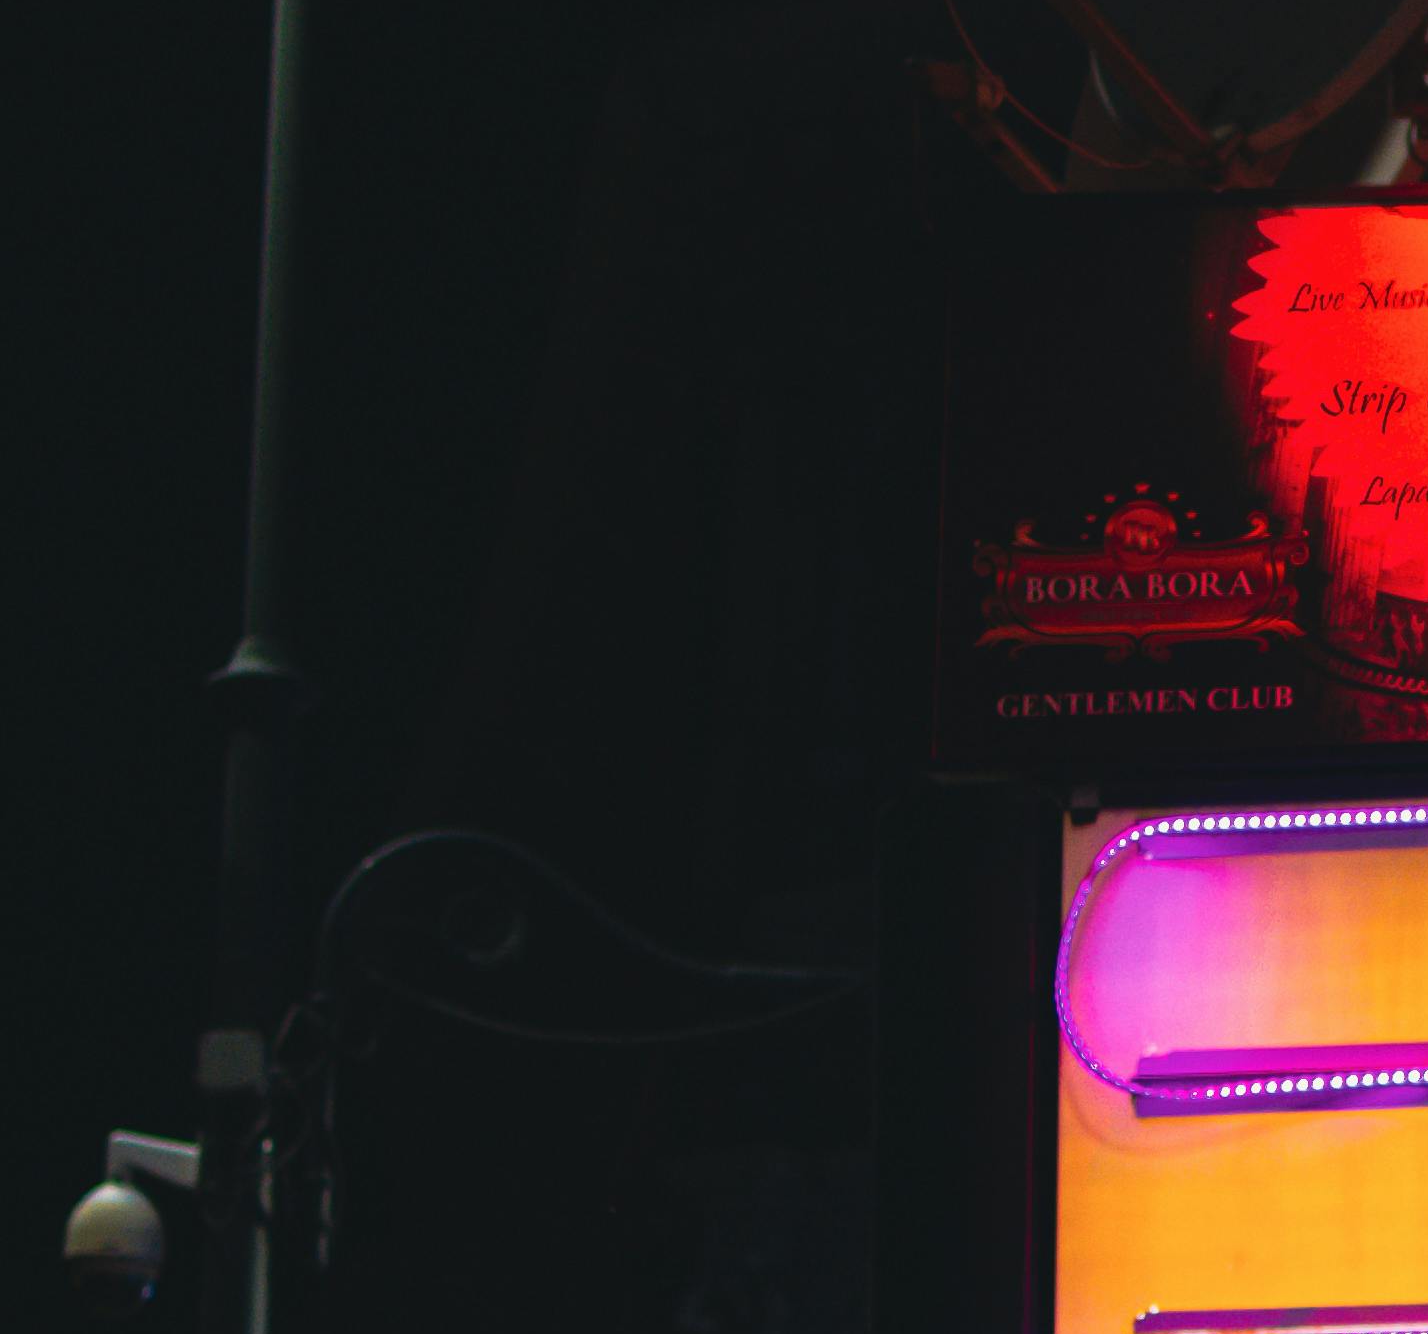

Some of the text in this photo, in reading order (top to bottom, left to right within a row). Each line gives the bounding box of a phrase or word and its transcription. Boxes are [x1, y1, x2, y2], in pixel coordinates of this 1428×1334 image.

[1288, 282, 1345, 313] Live
[1320, 378, 1408, 433] Strip
[1024, 569, 1255, 604] BORA BORA
[996, 684, 1295, 717] GENTLEMEN CLUB
